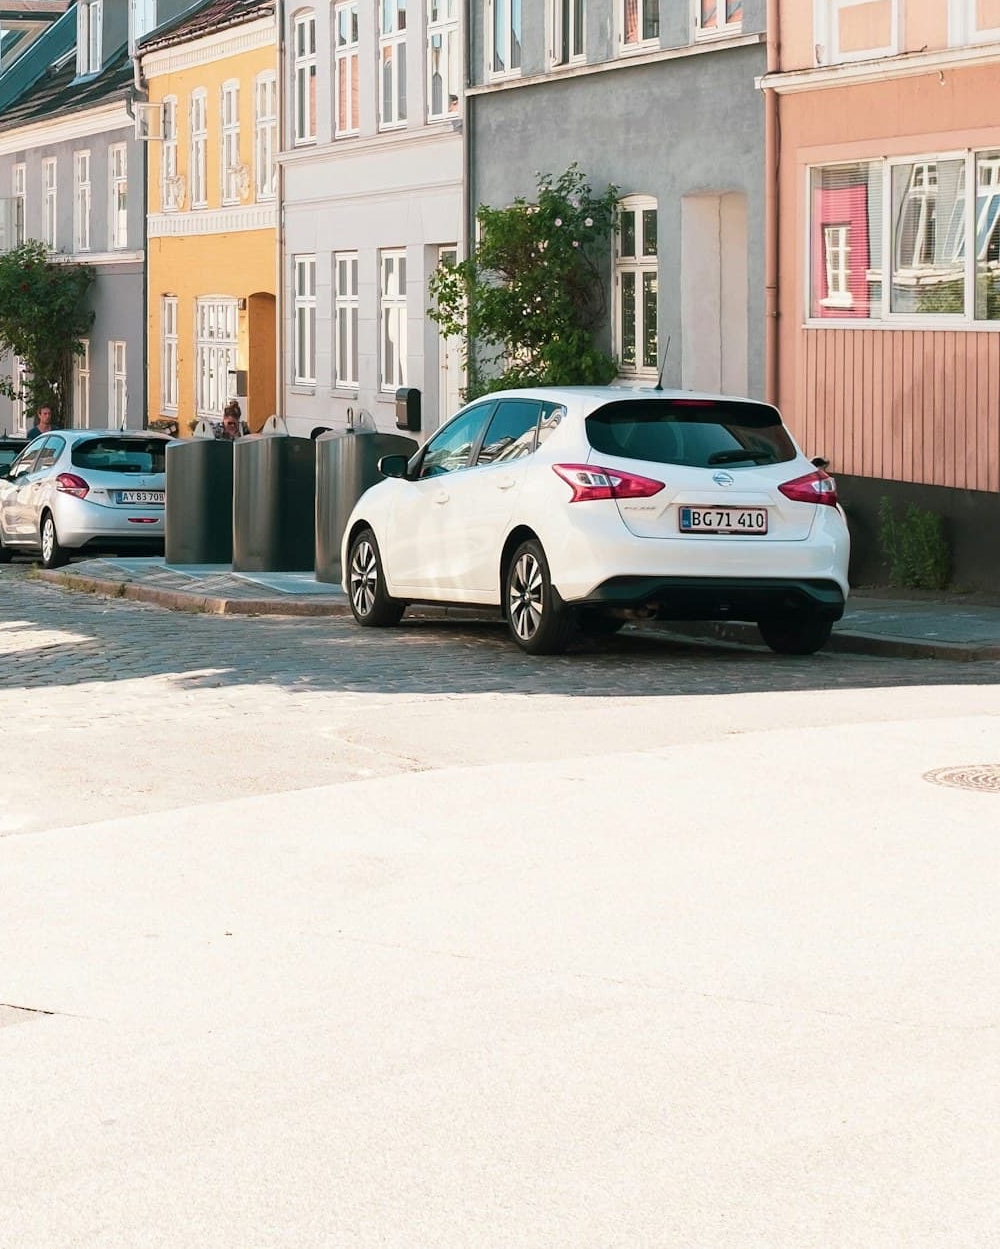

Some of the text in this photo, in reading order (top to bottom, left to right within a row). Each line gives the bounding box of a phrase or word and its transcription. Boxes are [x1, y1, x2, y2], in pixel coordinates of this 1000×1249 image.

[123, 492, 135, 501] AY
[136, 492, 147, 501] 83
[692, 511, 764, 528] BG 71 410
